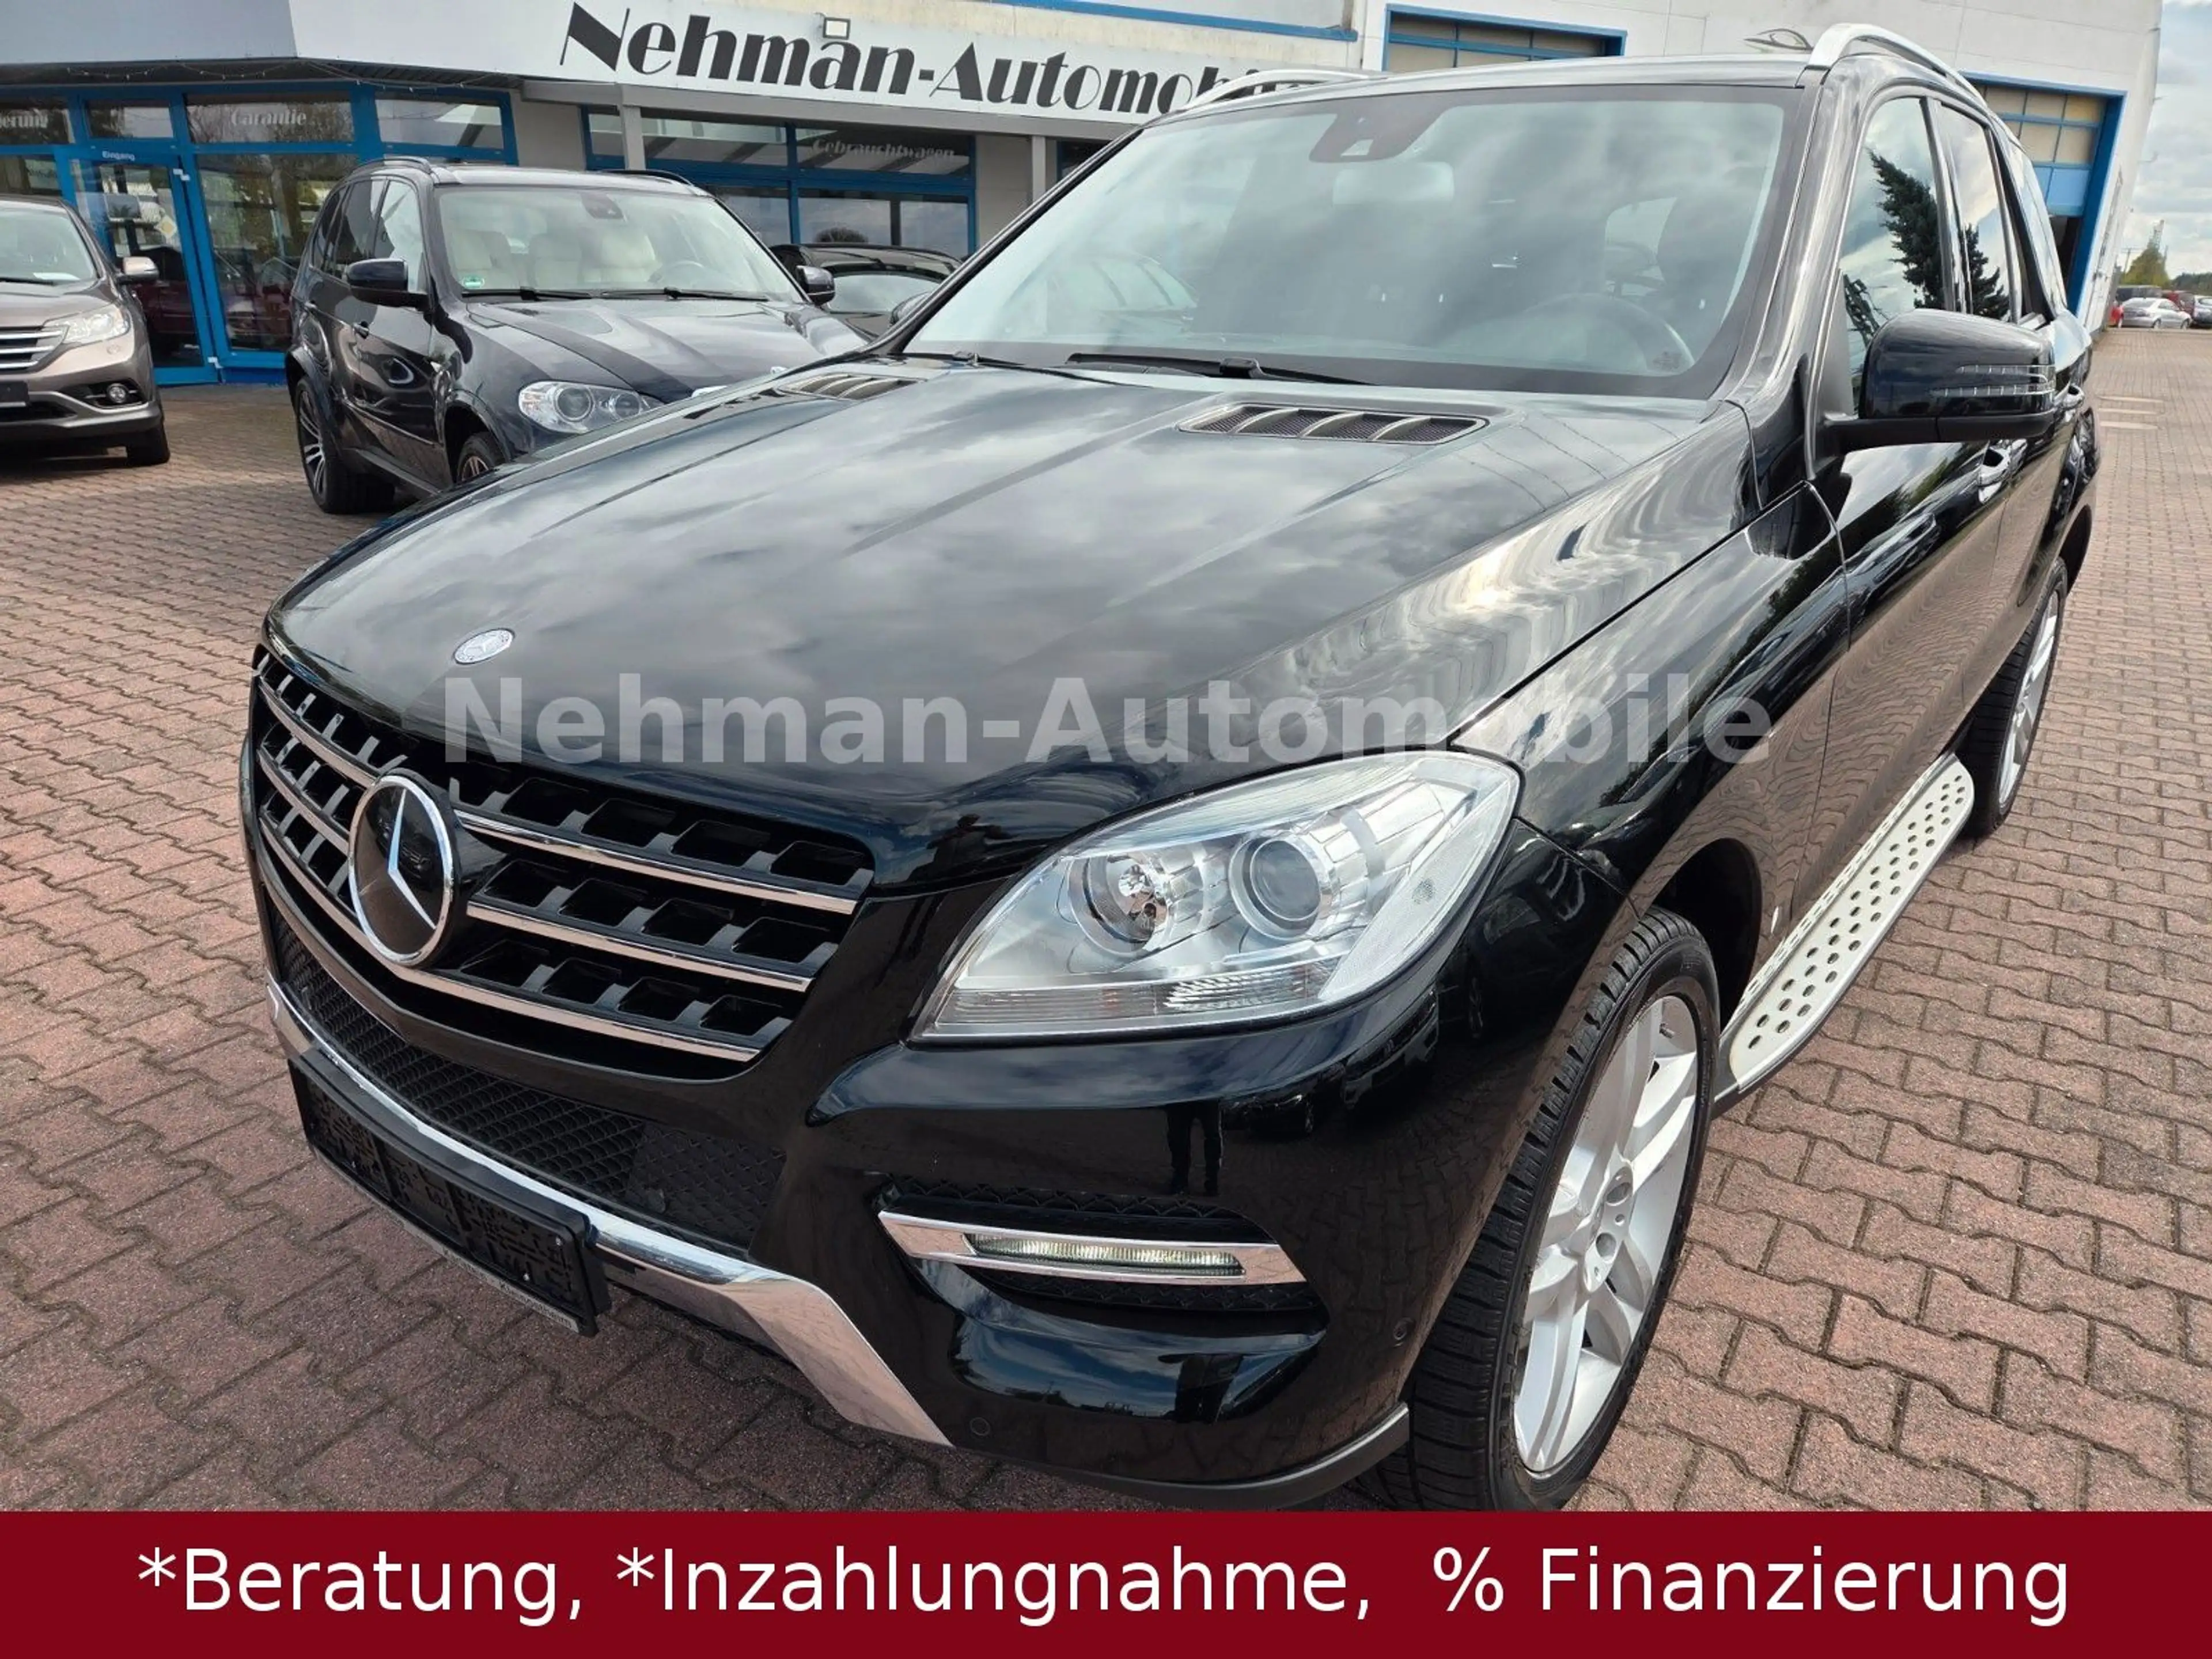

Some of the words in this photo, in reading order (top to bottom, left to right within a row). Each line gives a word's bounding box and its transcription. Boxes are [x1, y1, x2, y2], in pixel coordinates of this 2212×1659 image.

[559, 2, 1301, 115] Nehman-Automob
[232, 108, 306, 126] Garantie
[102, 150, 135, 161] Eingang
[812, 138, 955, 158] Gebrauchtwagen
